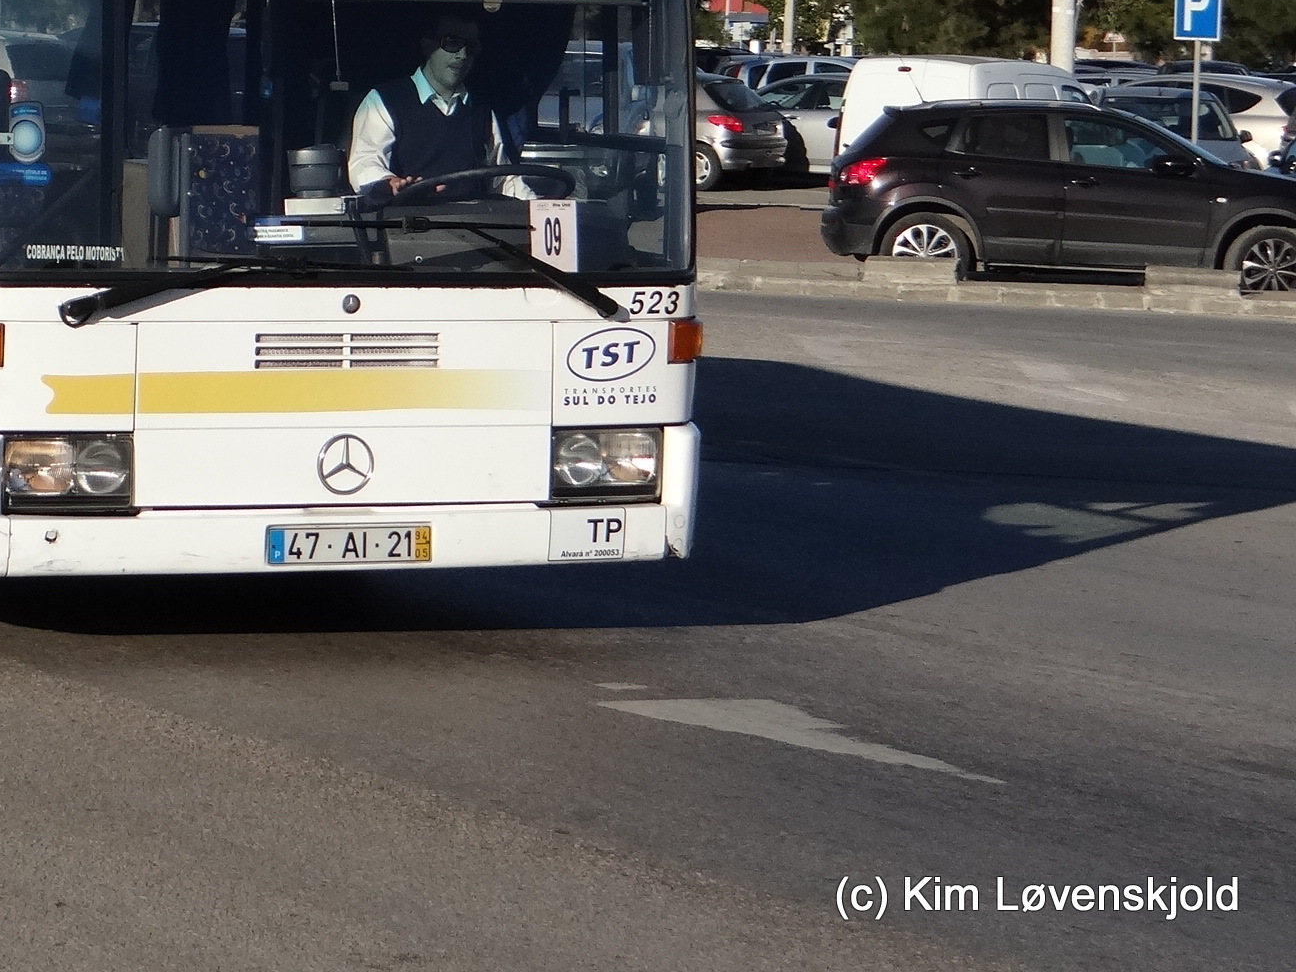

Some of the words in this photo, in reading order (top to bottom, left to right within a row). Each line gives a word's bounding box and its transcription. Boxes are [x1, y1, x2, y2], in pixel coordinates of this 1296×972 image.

[544, 217, 561, 256] 09
[26, 244, 65, 264] COBRANÇA
[66, 245, 84, 260] PELO
[629, 290, 680, 315] 523
[582, 340, 640, 369] TST
[563, 396, 589, 406] SUL
[597, 395, 616, 405] DO
[624, 394, 657, 405] TEJO
[564, 386, 657, 395] TRANSPORTES
[587, 518, 622, 543] TP
[274, 550, 281, 559] P
[560, 549, 583, 558] Alvará
[594, 548, 620, 557] 200053
